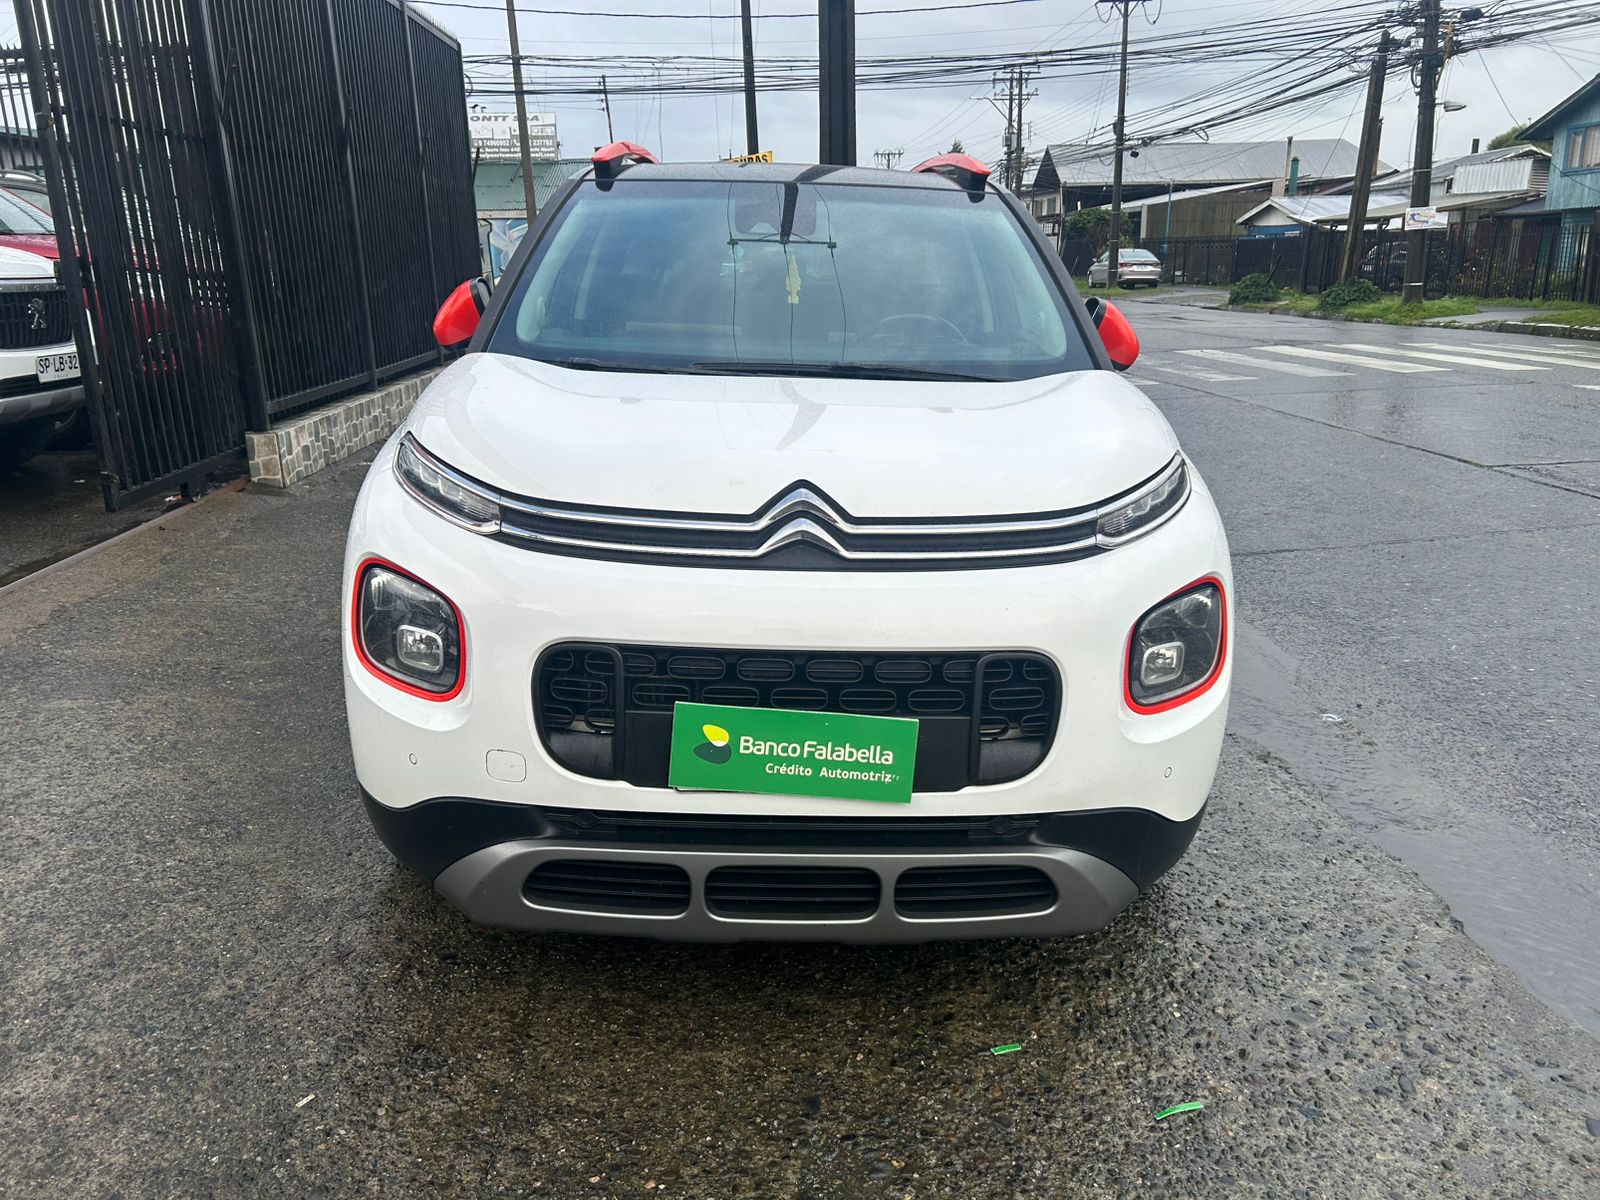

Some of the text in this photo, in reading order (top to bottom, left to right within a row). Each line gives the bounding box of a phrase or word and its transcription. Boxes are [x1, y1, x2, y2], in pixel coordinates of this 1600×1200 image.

[738, 735, 894, 765] Banco Falabella
[765, 763, 892, 782] Crédito Automotriz
